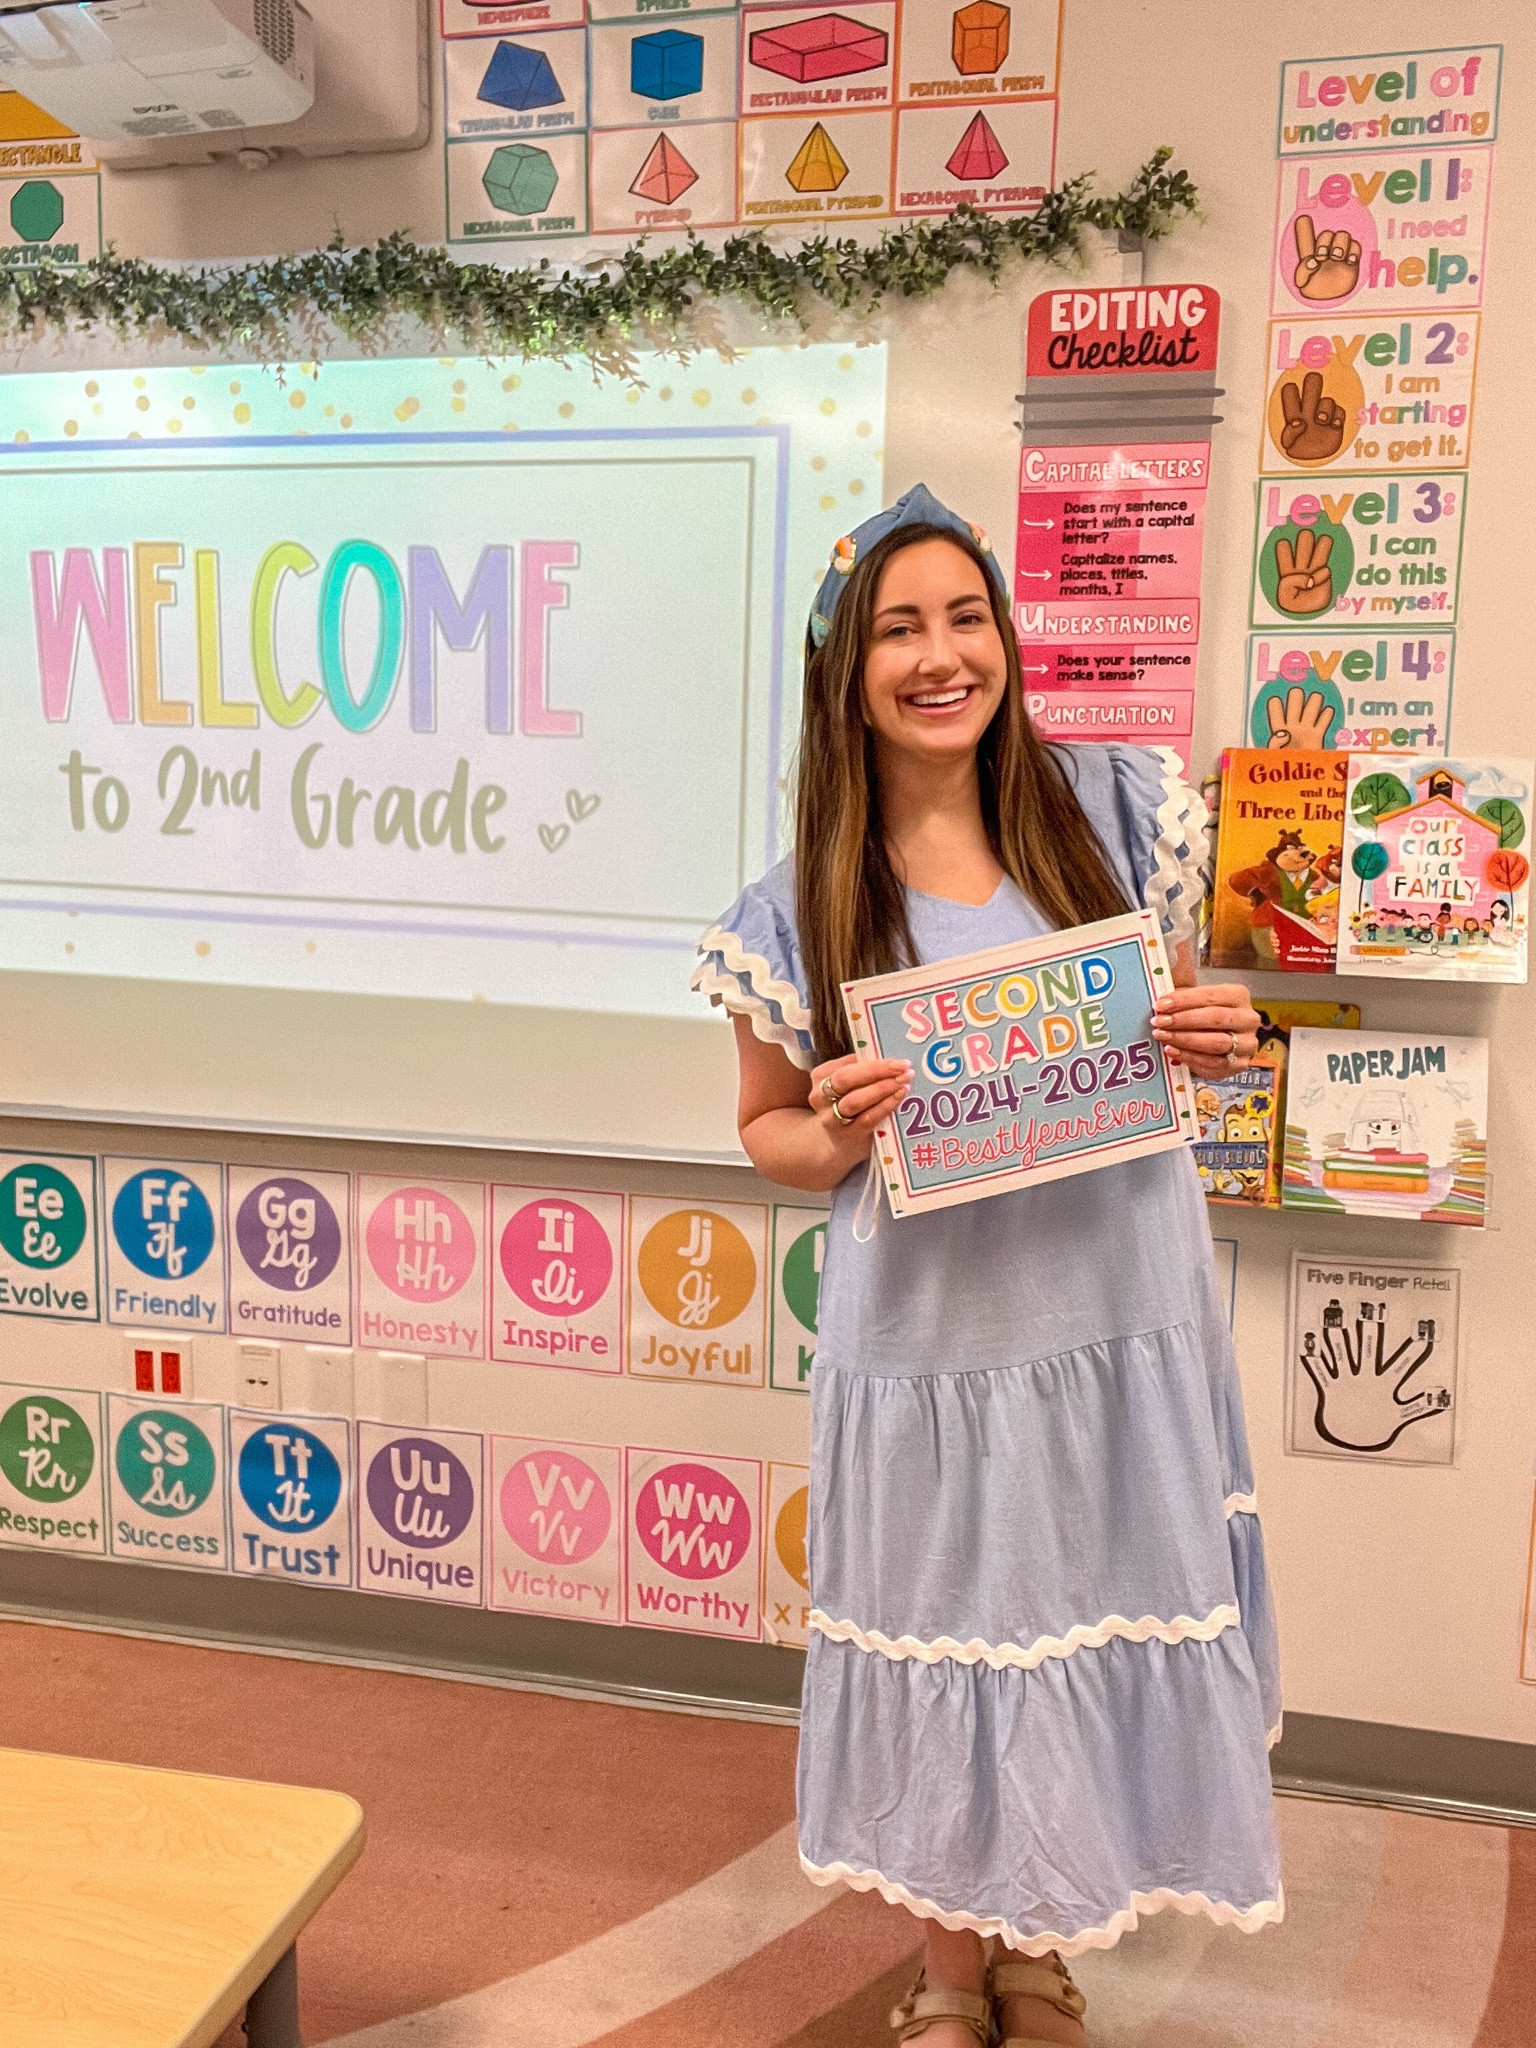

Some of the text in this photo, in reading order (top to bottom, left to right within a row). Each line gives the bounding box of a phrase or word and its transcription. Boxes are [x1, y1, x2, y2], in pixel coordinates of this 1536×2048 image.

[1297, 56, 1482, 108] Level of
[1284, 109, 1490, 143] understanding
[1296, 158, 1432, 209] Level
[1387, 215, 1468, 239] I need
[1369, 248, 1478, 294] help.
[1051, 288, 1206, 332] EDITING
[1048, 329, 1200, 369] Checklist
[1277, 322, 1469, 370] Level 2:
[1385, 374, 1440, 393] I am
[1356, 400, 1467, 427] starting
[1354, 434, 1462, 462] to get it.
[1063, 500, 1187, 516] Does my sentence
[1063, 514, 1195, 529] start with a capital
[1267, 482, 1455, 527] Level 3:
[1062, 532, 1109, 544] letter?
[1369, 534, 1436, 555] I can
[1061, 553, 1125, 568] Capitalize
[1356, 562, 1447, 586] do this
[1115, 583, 1123, 595] I
[1335, 591, 1453, 616] by myself.
[29, 538, 583, 738] WELCOME
[1020, 605, 1192, 635] UNDERSTANDING
[1057, 653, 1191, 669] Does your sentence
[1057, 669, 1145, 681] make sense?
[1257, 640, 1445, 683] Level 4:
[1347, 698, 1433, 716] I am an
[1334, 724, 1444, 751] expert.
[1249, 761, 1325, 784] Goldie
[59, 742, 508, 854] to 2nd Grade
[1237, 800, 1296, 820] Three
[1300, 787, 1322, 798] and
[1394, 876, 1478, 901] FAMILY
[1417, 862, 1450, 876] is a
[902, 956, 1116, 1043] SECOND
[923, 1002, 1110, 1084] GRADE
[1327, 1046, 1446, 1084] PAPER JAM
[898, 1041, 1157, 1138] 2024-2025
[911, 1098, 1165, 1170] #BestYearEver
[15, 1177, 64, 1220] Ee
[141, 1178, 191, 1223] Ff
[258, 1186, 317, 1240] Gg
[394, 1198, 453, 1245] Hh
[537, 1207, 575, 1253] Ii
[677, 1215, 712, 1267] Jj
[22, 1221, 62, 1262] Ee
[1307, 1269, 1344, 1285] Five
[1348, 1270, 1409, 1291] Finger
[115, 1288, 217, 1323] Friendly
[238, 1300, 342, 1328] Gratitude
[363, 1312, 478, 1349] Honesty
[503, 1320, 608, 1356] Inspire
[641, 1335, 751, 1377] Joyful
[25, 1406, 70, 1445] Rr
[138, 1420, 190, 1467] Ss
[265, 1434, 312, 1480] Tt
[390, 1447, 450, 1496] Uu
[525, 1461, 594, 1511] Vv
[654, 1479, 735, 1525] Ww
[0, 1506, 98, 1540] Respect
[118, 1520, 219, 1555] Success
[243, 1533, 340, 1577] Trust
[367, 1546, 474, 1591] Unique
[502, 1567, 610, 1609] Victory
[637, 1583, 750, 1628] Worthy
